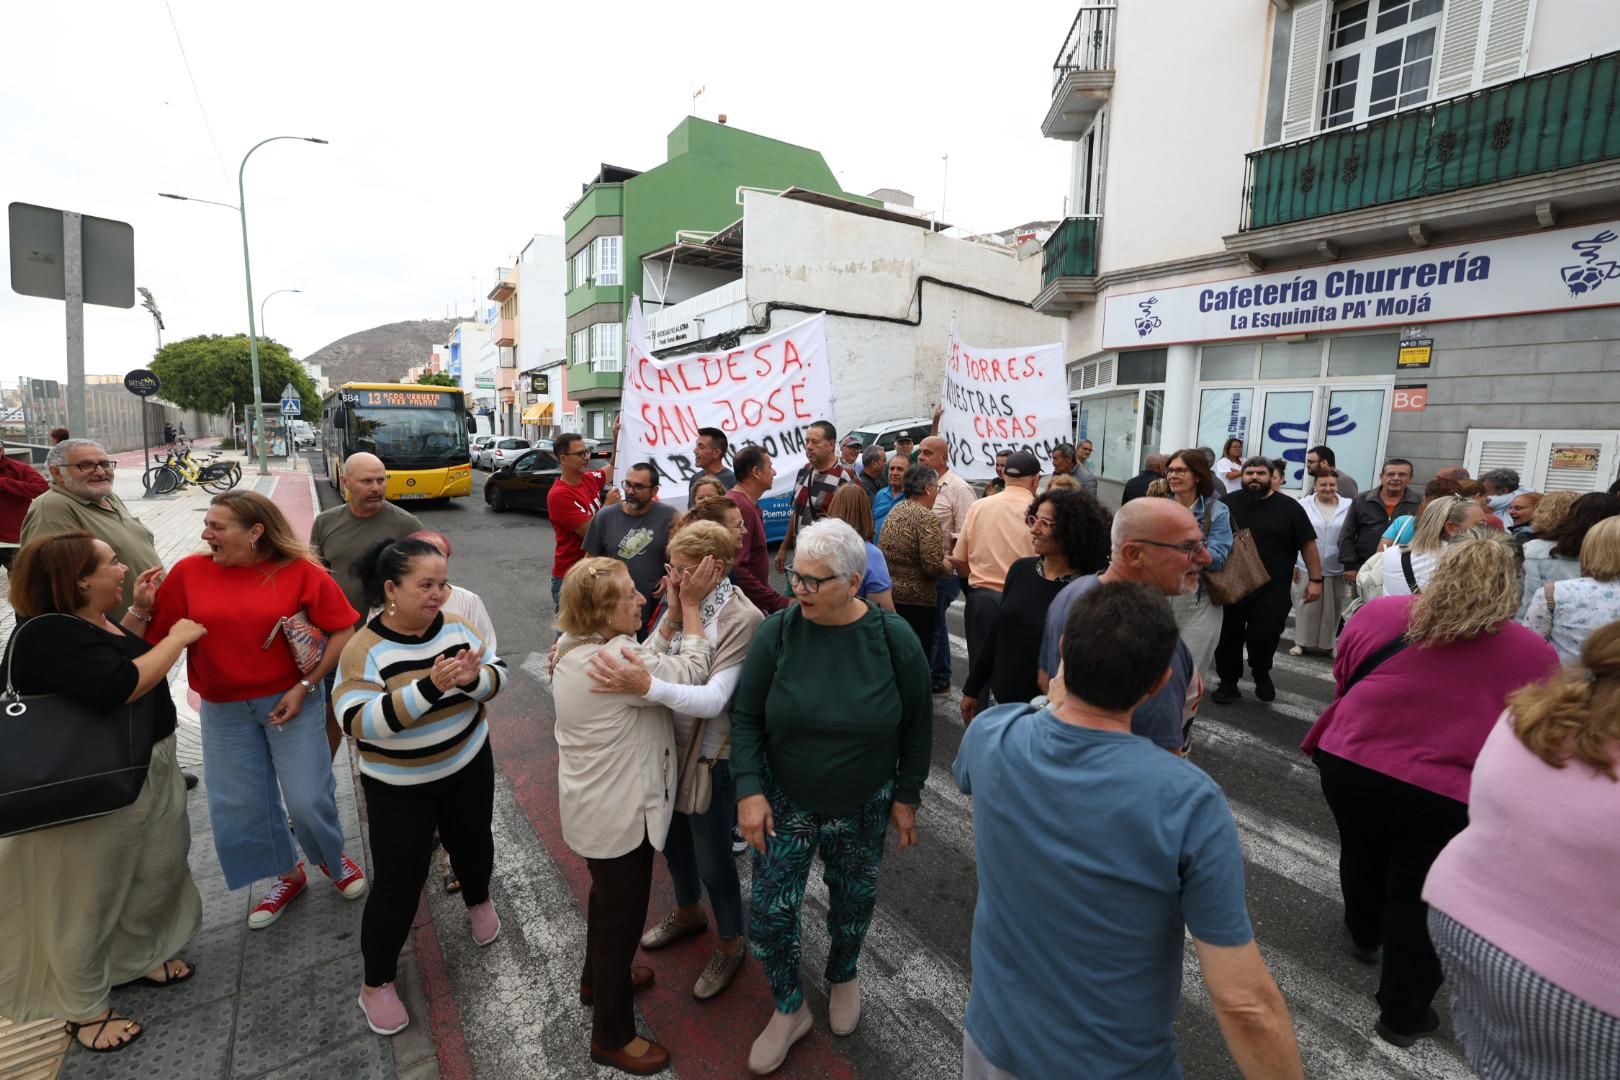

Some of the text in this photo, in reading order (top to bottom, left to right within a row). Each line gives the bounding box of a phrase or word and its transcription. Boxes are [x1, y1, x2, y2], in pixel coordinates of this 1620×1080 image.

[1199, 251, 1491, 313] Cafetería Churrería
[1230, 314, 1248, 330] La
[1252, 306, 1337, 329] Esquinita
[1376, 292, 1431, 317] Mojá
[963, 354, 1044, 383] TORRES.
[368, 392, 381, 405] 13
[946, 376, 1013, 417] NUESTRAS
[1394, 392, 1423, 409] Bc
[973, 415, 1038, 440] CASAS
[946, 431, 975, 468] NO
[762, 509, 786, 518] Poema
